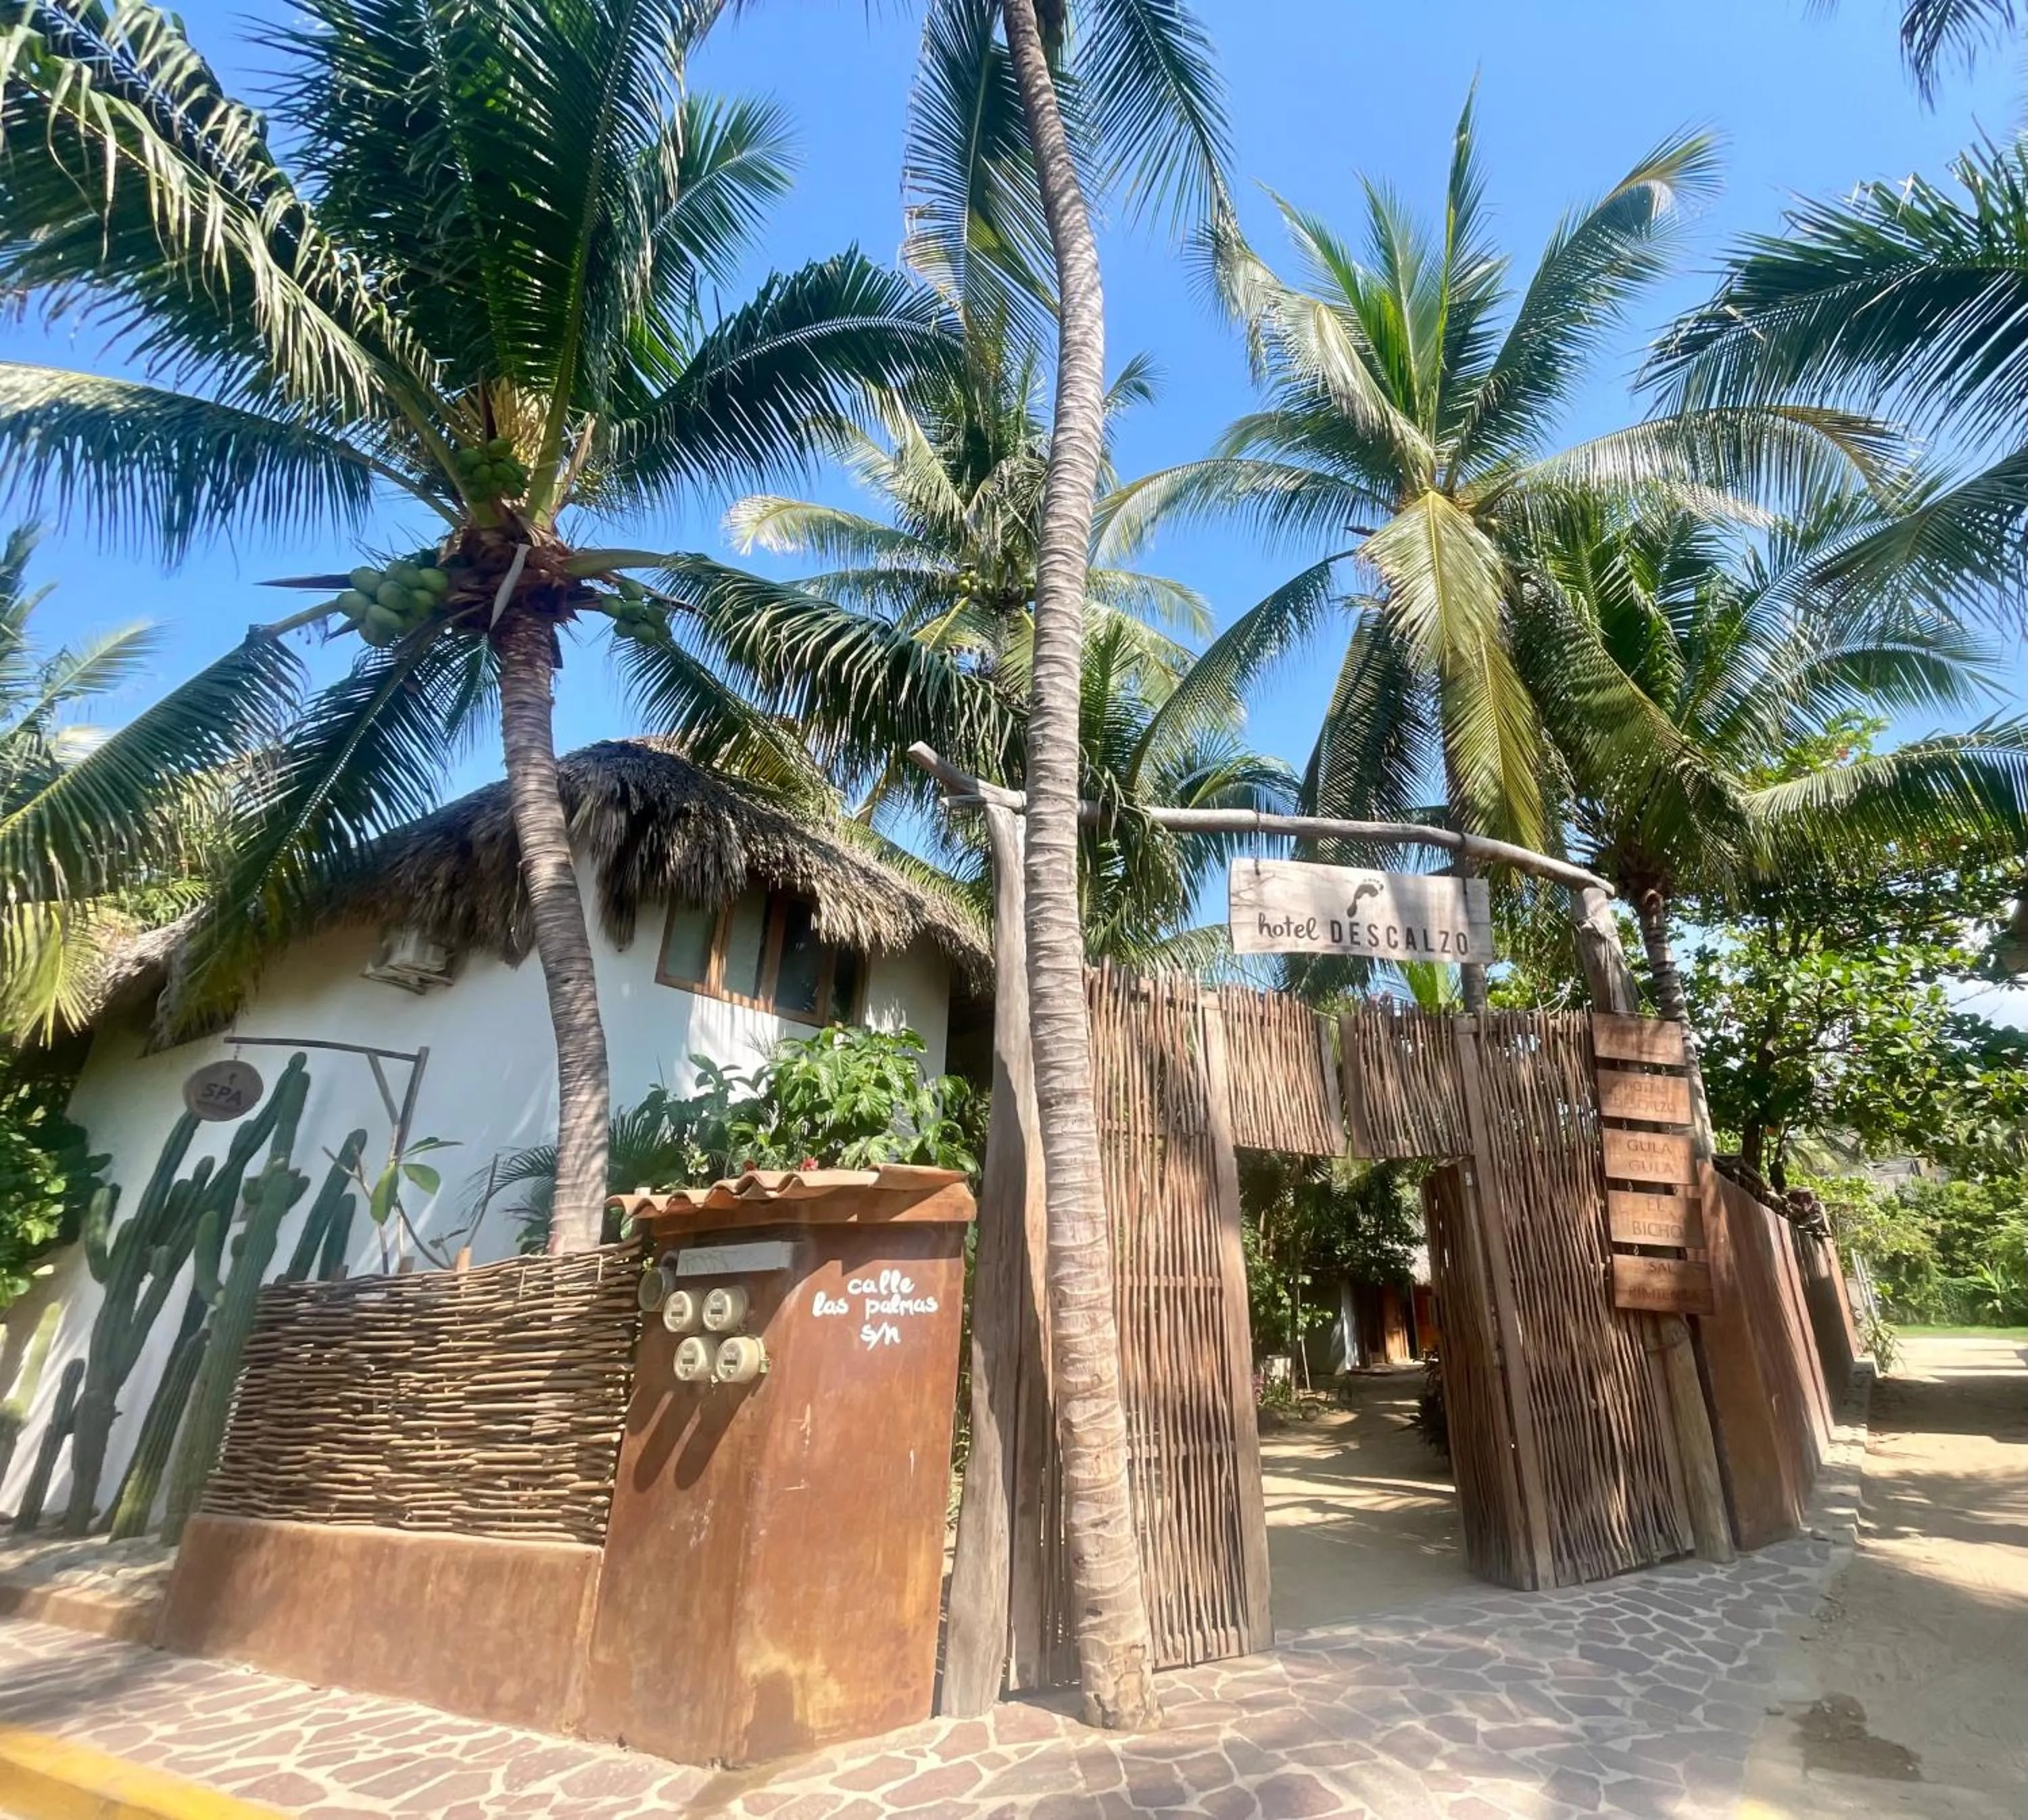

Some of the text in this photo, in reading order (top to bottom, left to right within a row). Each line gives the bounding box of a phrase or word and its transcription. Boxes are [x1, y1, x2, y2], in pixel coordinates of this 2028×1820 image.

[1257, 912, 1469, 956] hotel DESCALZO
[201, 1082, 242, 1107] SPA
[1627, 1139, 1672, 1155] GULA
[1628, 1159, 1675, 1174] GULA
[1632, 1220, 1683, 1239] BICHO
[847, 1269, 915, 1295] calle
[812, 1291, 938, 1320] las palmas
